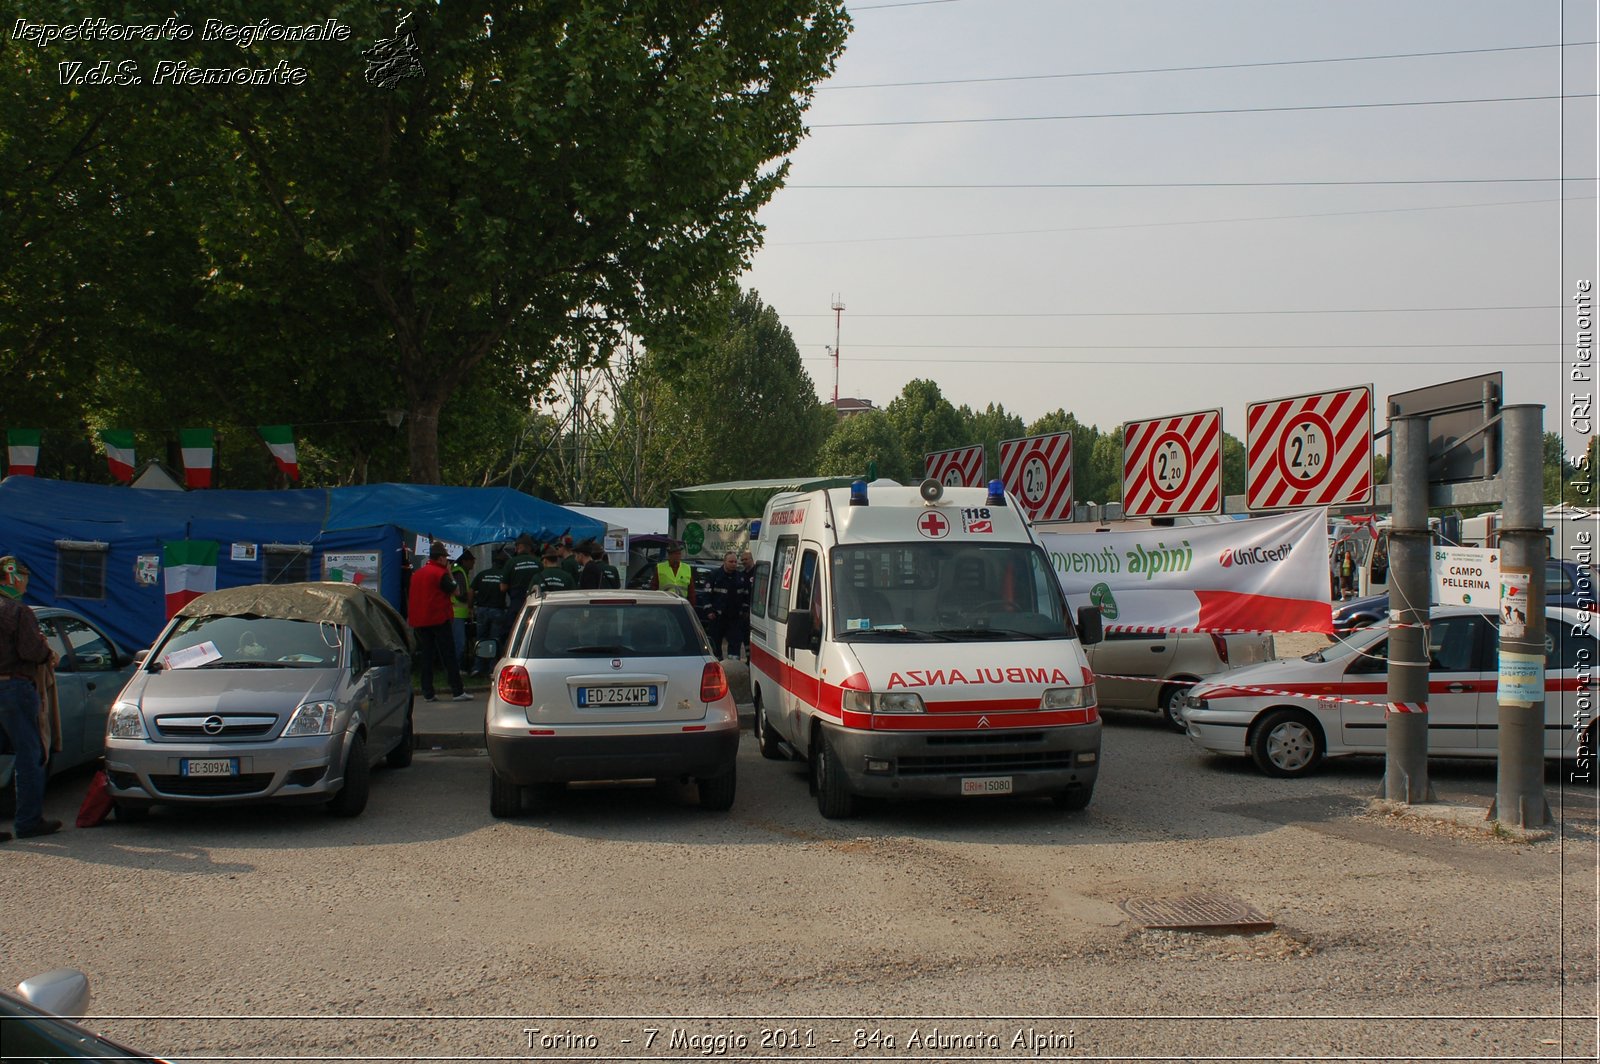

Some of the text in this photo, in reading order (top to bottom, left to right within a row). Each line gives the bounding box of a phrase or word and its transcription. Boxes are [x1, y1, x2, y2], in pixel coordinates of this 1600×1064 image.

[964, 508, 991, 519] 118
[1033, 540, 1193, 580] nvenuti alpini
[1233, 543, 1294, 566] UniCredit
[1449, 566, 1482, 577] CAMPO
[1442, 578, 1490, 590] PELLERINA
